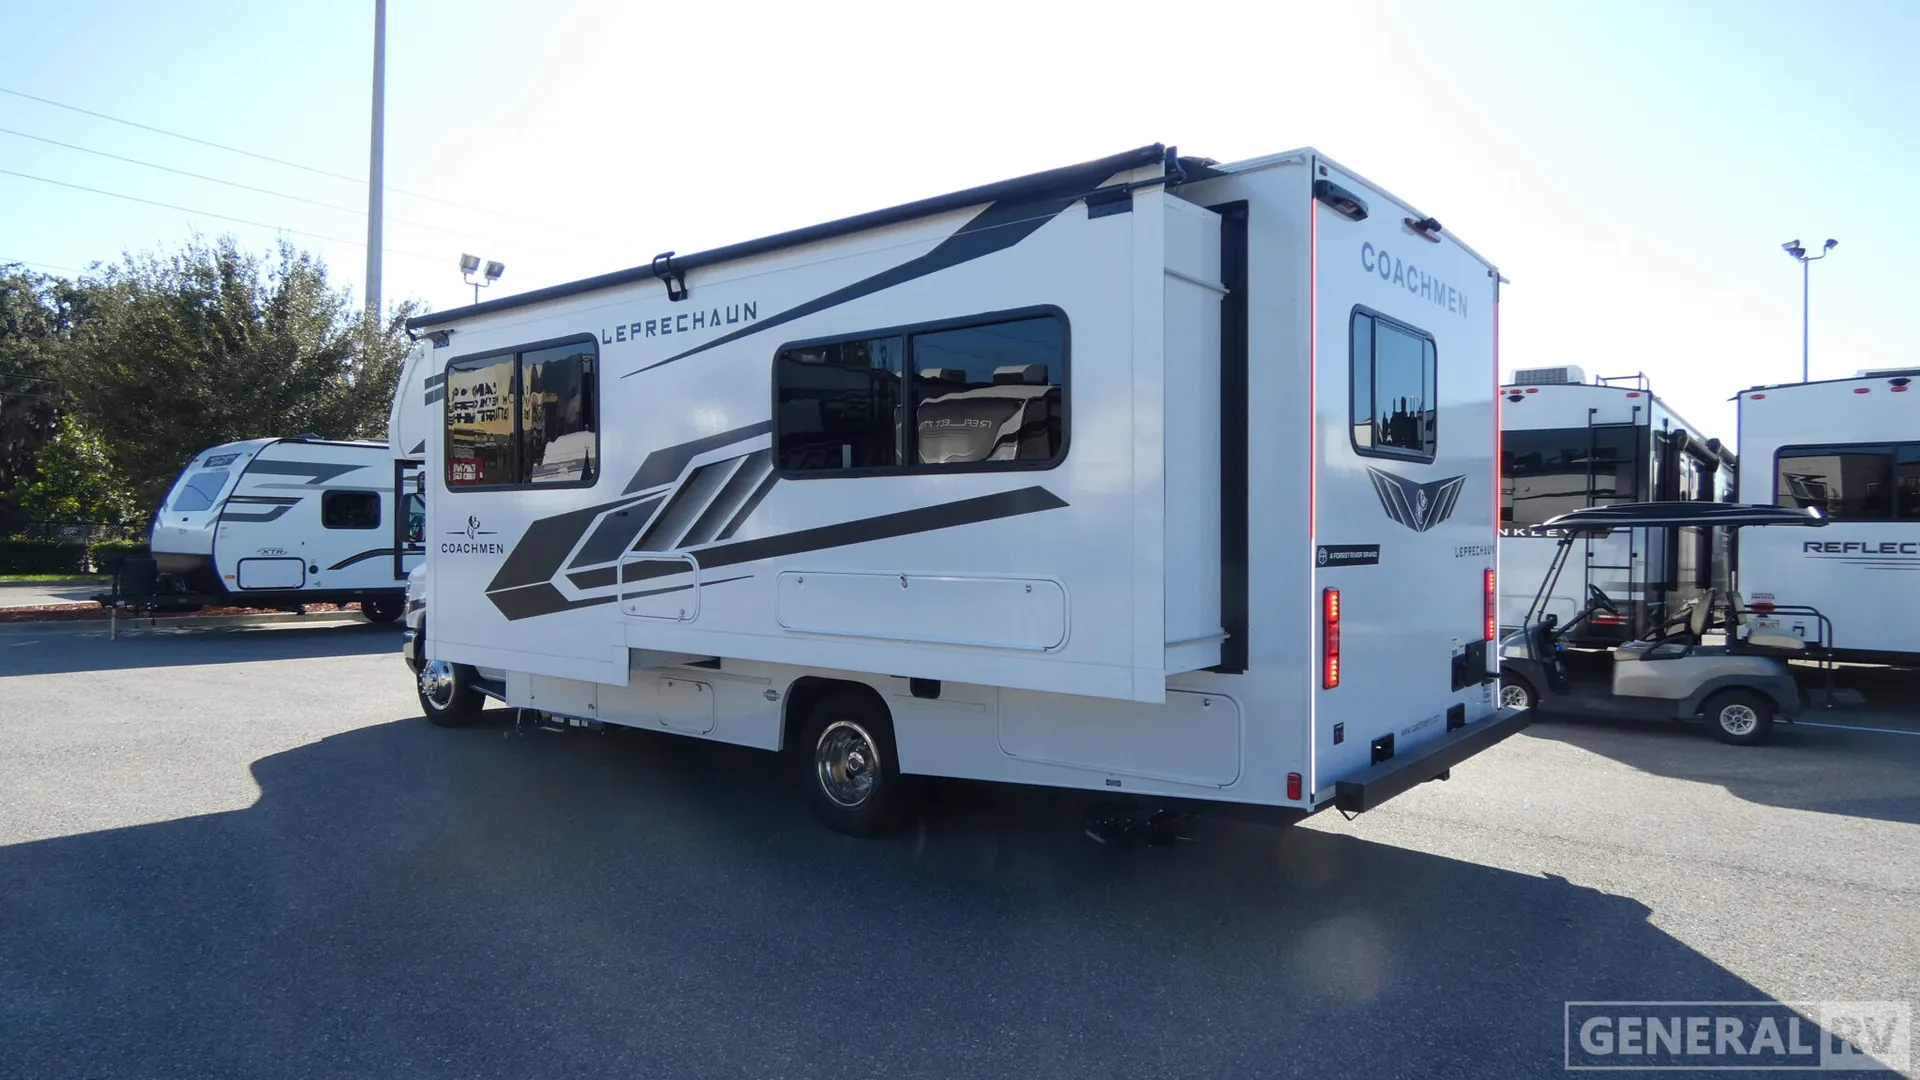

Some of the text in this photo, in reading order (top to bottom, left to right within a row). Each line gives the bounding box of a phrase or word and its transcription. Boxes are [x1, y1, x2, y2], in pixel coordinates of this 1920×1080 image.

[1361, 241, 1468, 319] COACHMEN
[602, 301, 757, 345] LEPRECHAUN
[441, 543, 504, 554] COACHMEN
[1803, 541, 1920, 555] REFLEC
